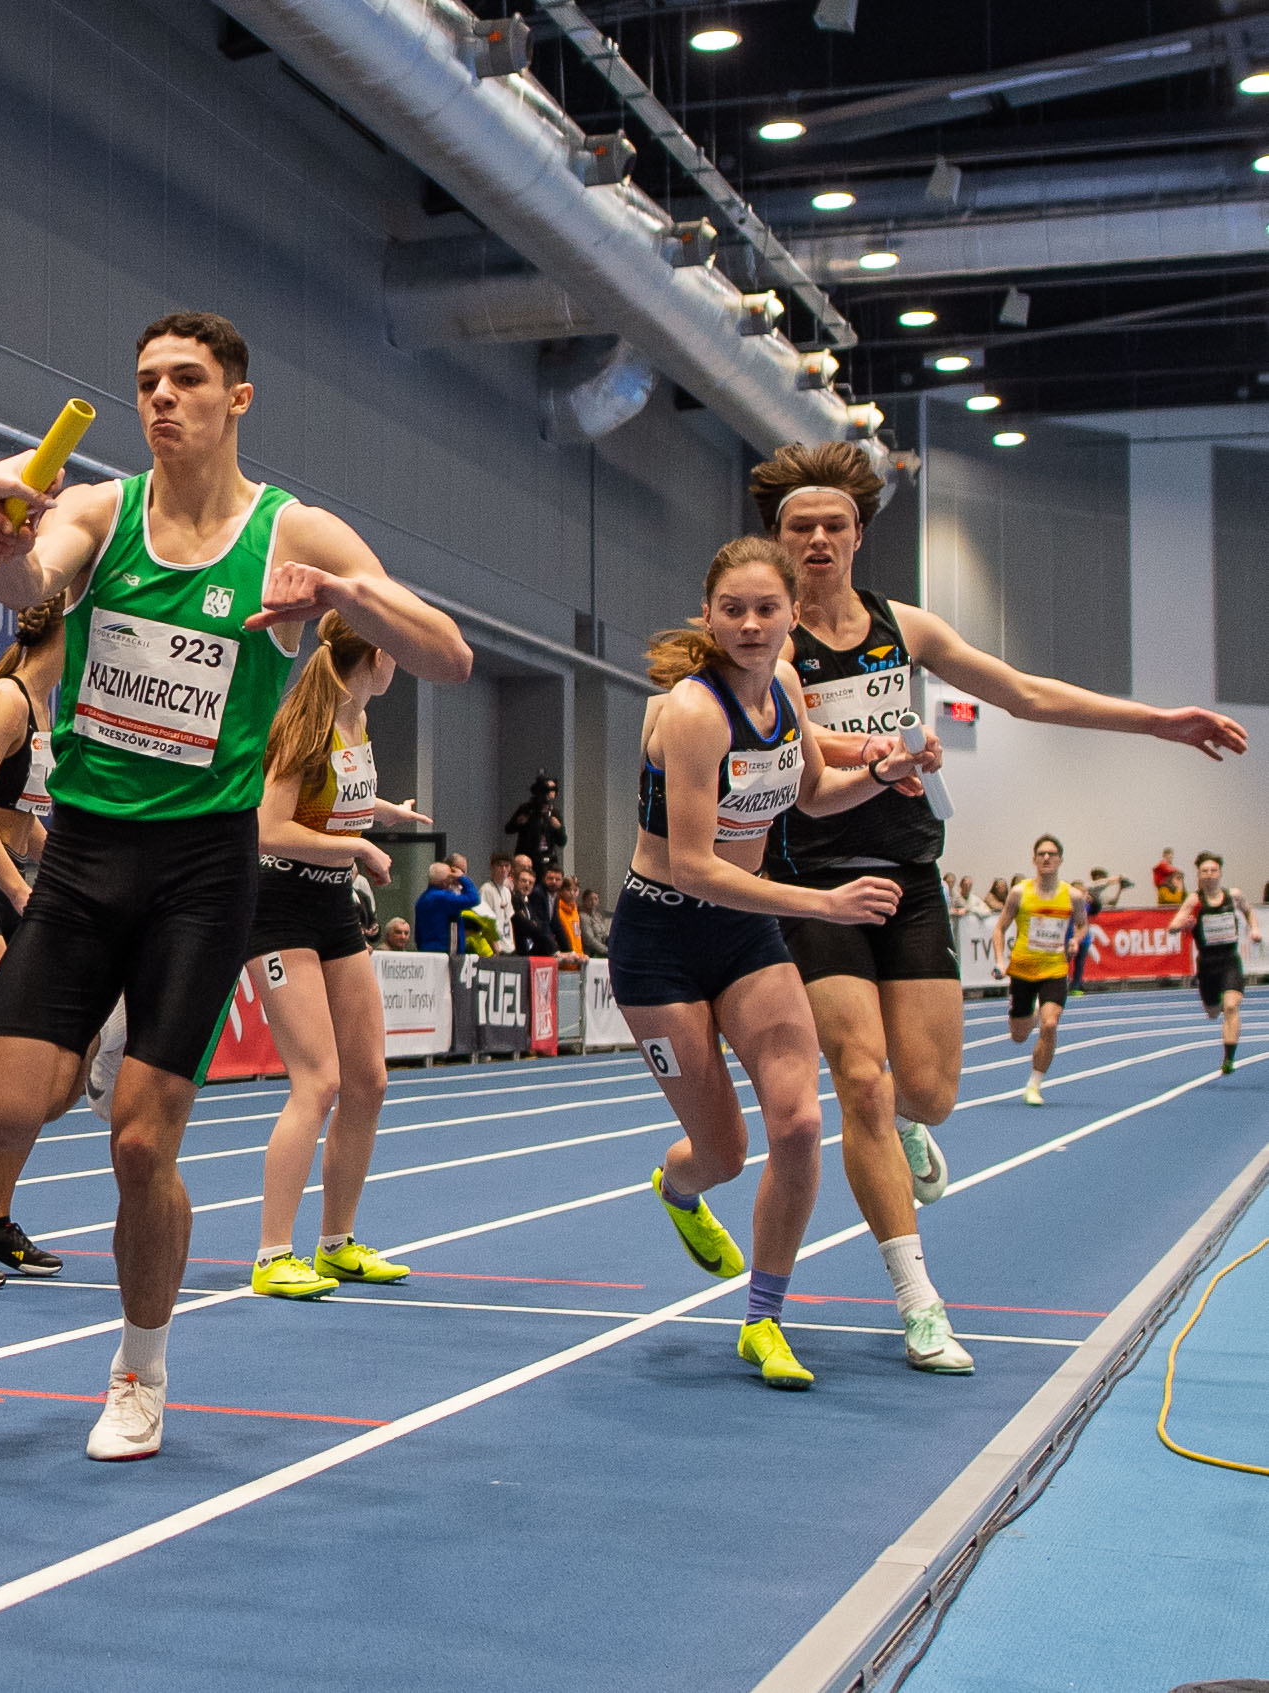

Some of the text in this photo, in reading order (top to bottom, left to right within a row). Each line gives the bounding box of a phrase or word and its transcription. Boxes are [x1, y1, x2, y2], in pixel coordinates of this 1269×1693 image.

[169, 634, 224, 668] 923
[87, 661, 222, 721] KAZIMIERCZYK
[867, 672, 905, 697] 679
[824, 707, 908, 735] UBAC
[97, 725, 182, 756] RZESZÓW 2023
[778, 746, 798, 771] 687
[719, 781, 798, 813] ZAKRZEWSKA
[1114, 928, 1182, 957] ORLEN
[268, 957, 283, 981] 5
[381, 959, 425, 980] Ministerstwo
[649, 1043, 669, 1074] 6
